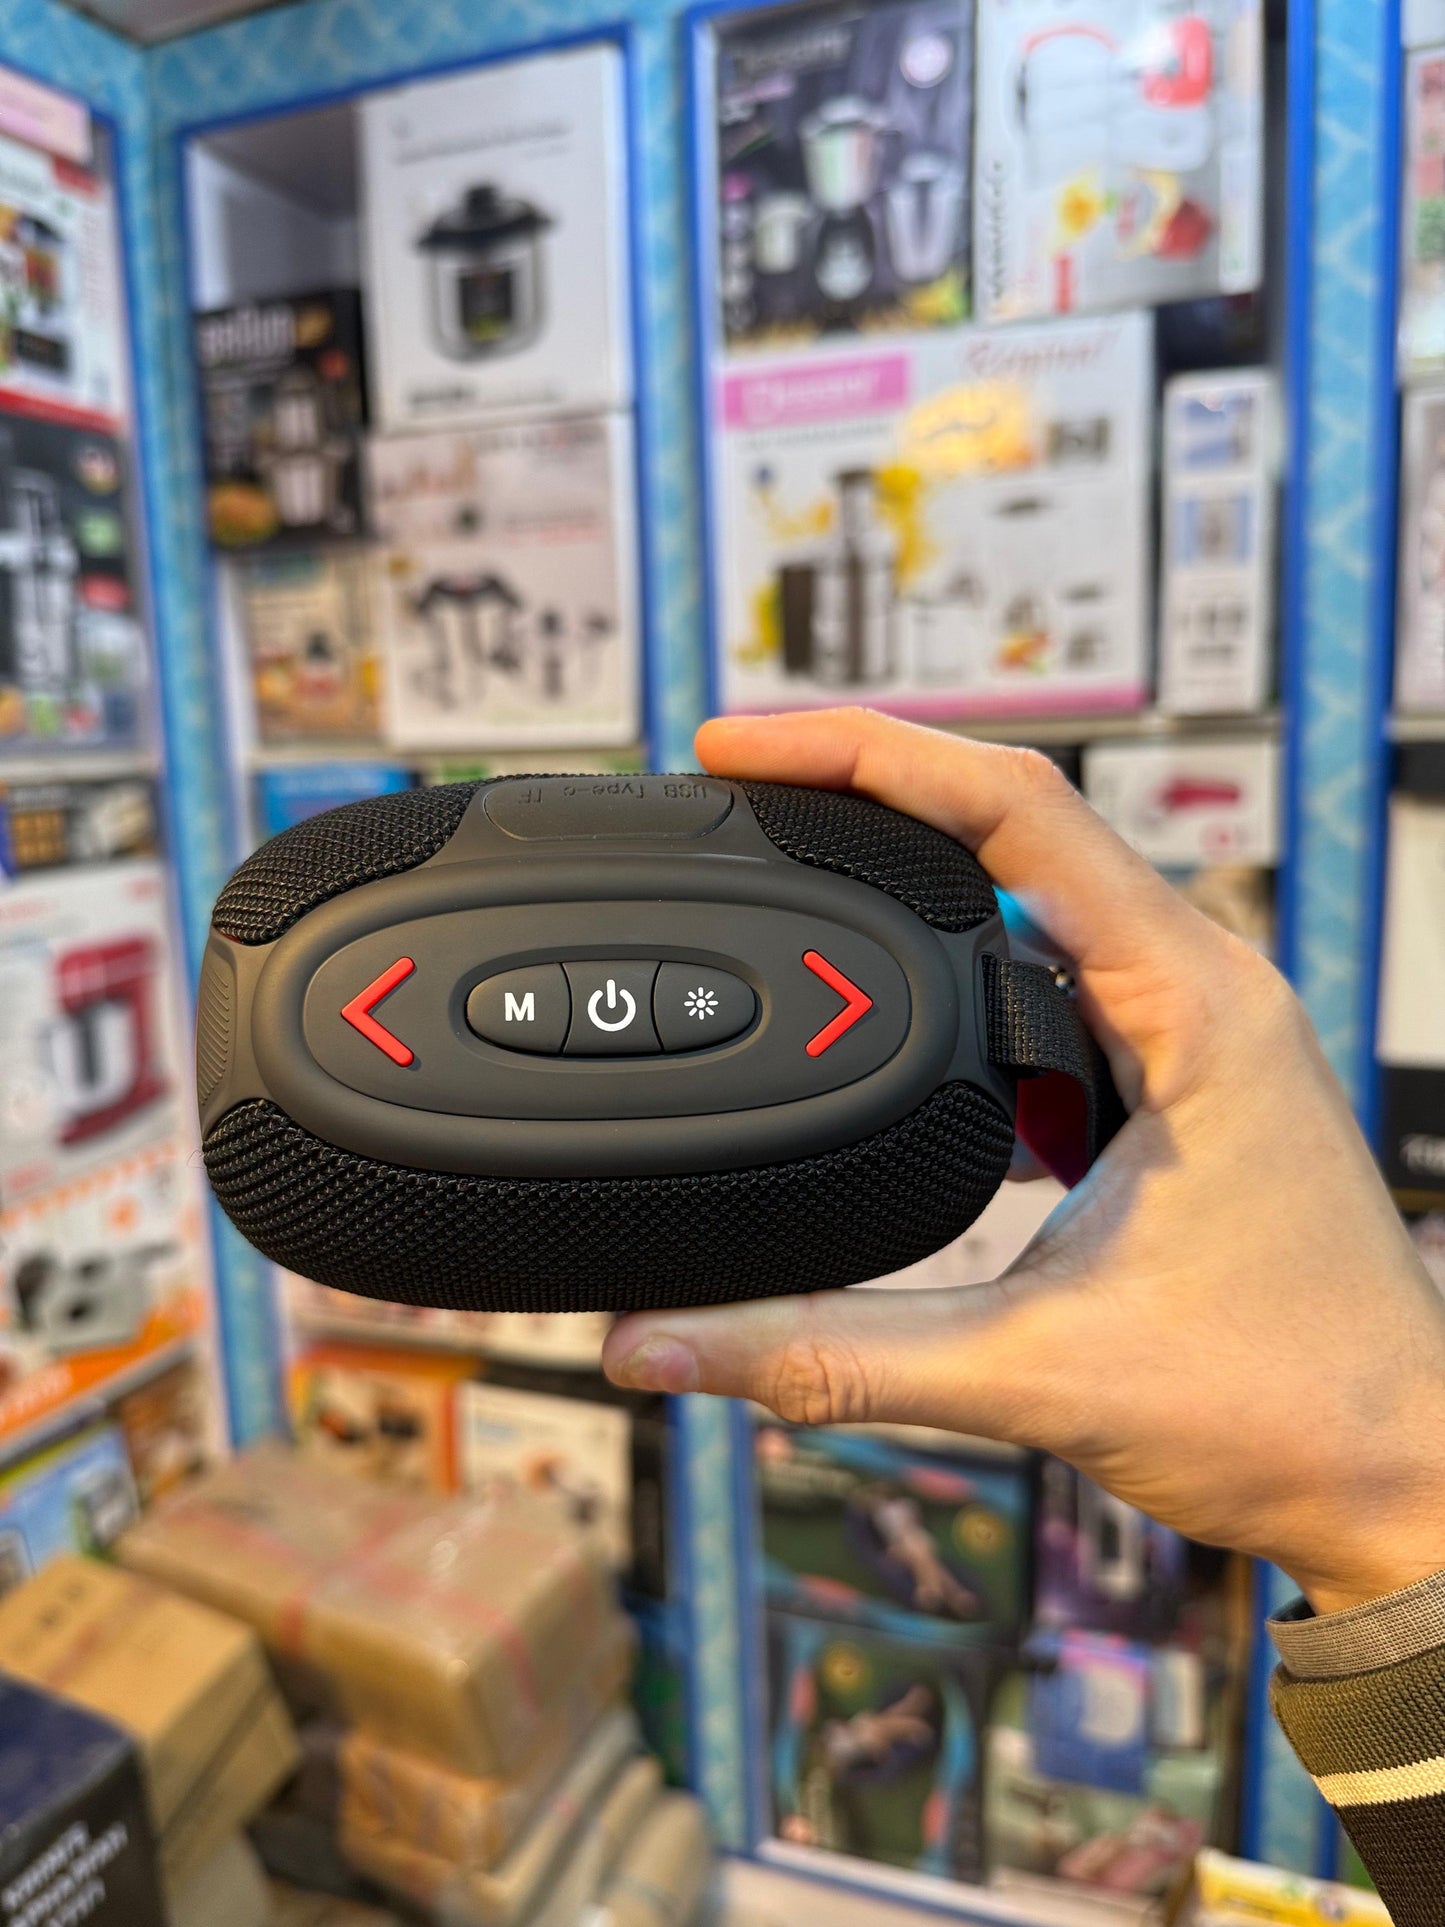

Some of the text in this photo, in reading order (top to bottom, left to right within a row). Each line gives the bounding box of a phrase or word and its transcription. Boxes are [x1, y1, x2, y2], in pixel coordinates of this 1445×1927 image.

[518, 787, 543, 804] TF
[664, 783, 707, 799] USB
[504, 992, 535, 1022] M
